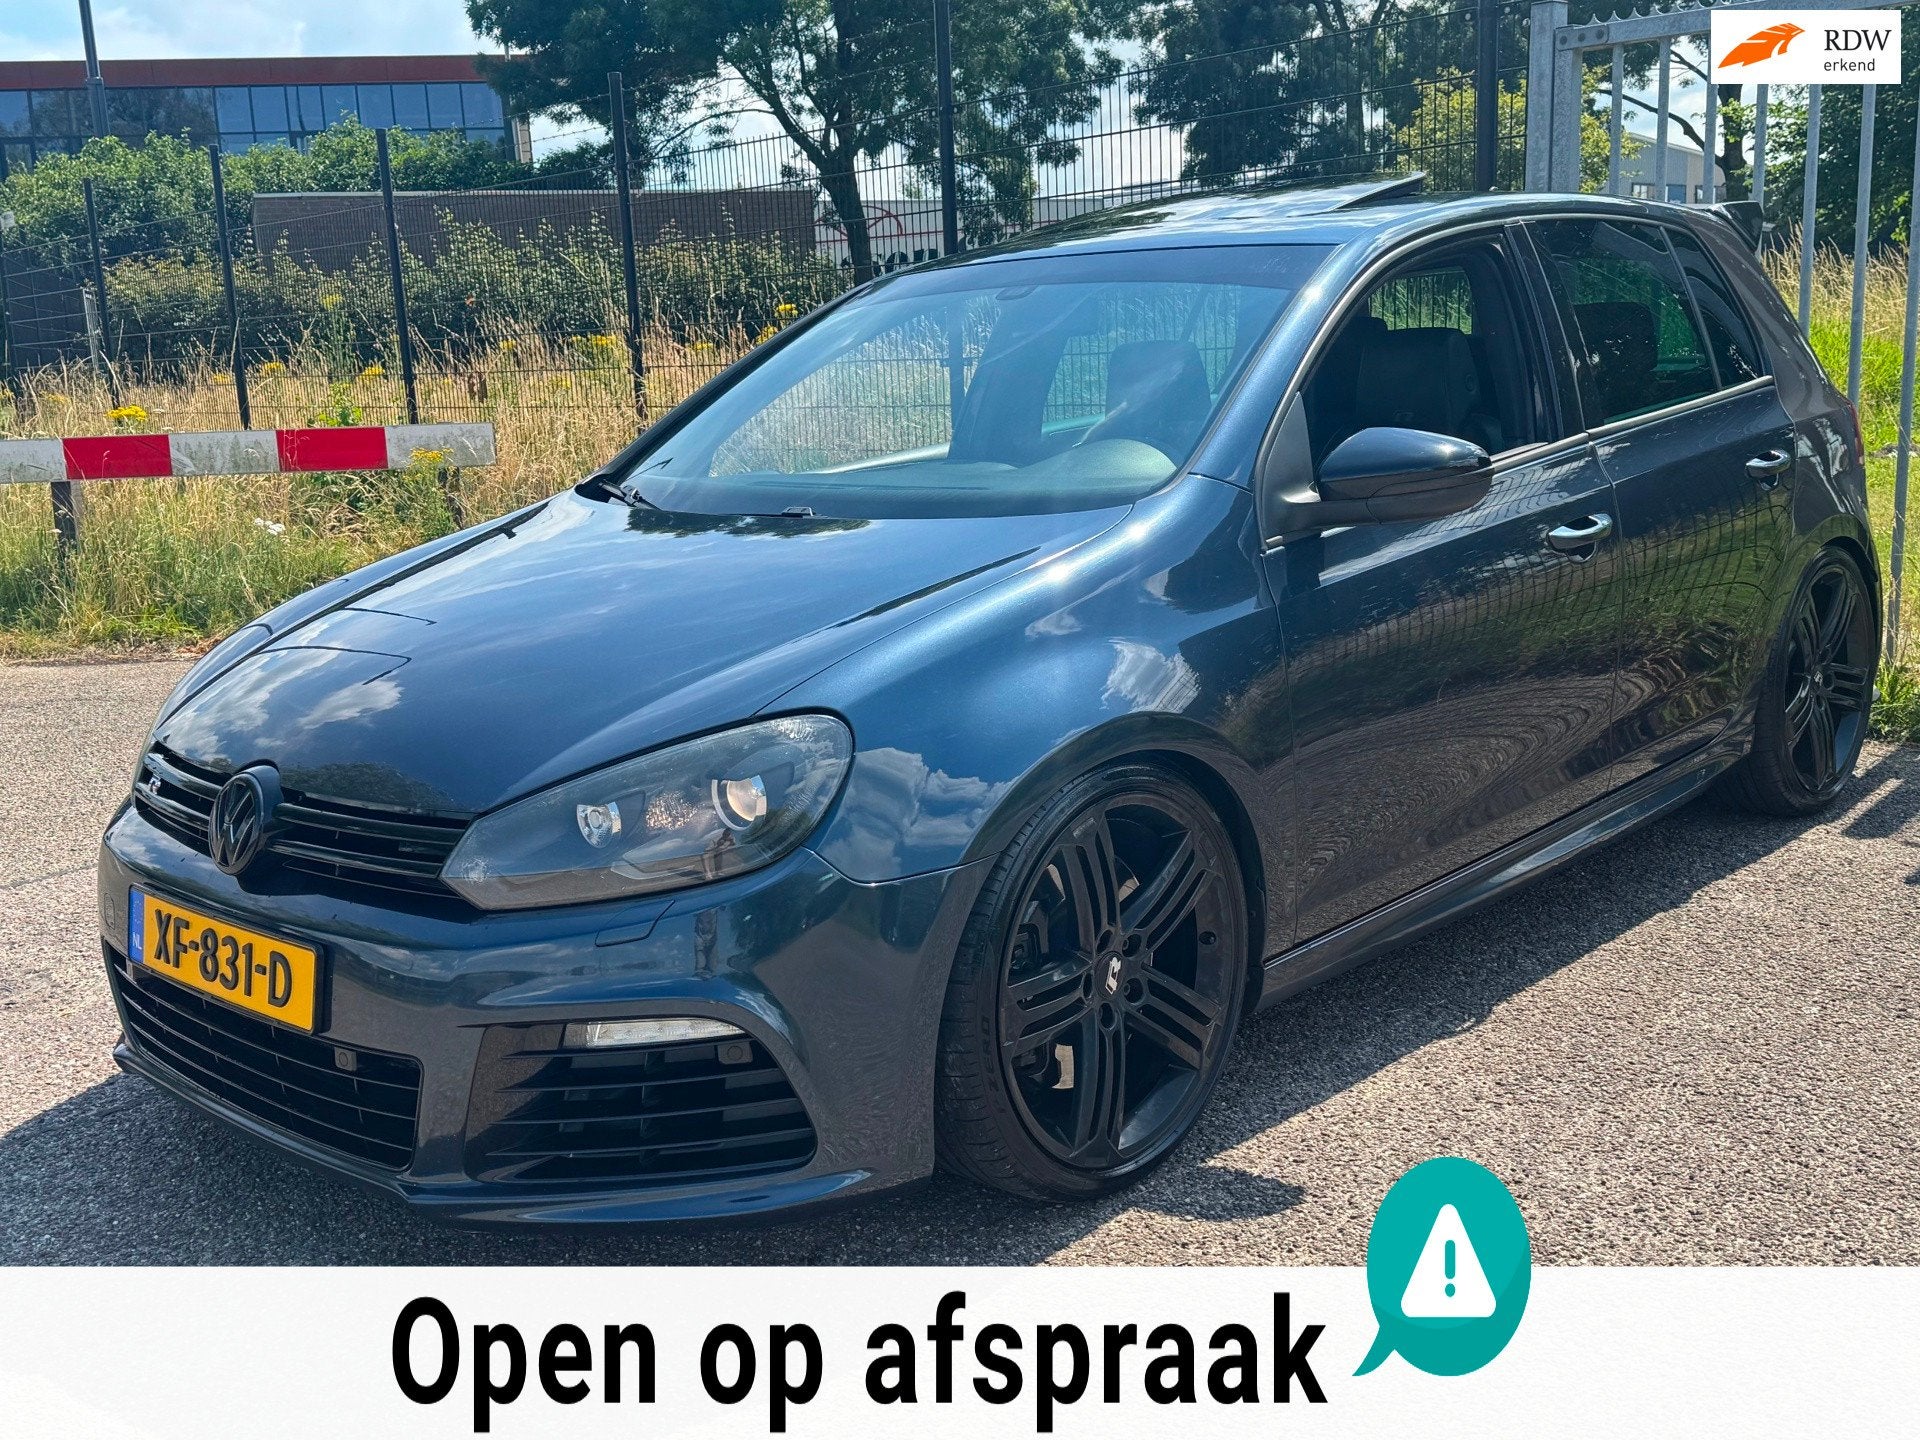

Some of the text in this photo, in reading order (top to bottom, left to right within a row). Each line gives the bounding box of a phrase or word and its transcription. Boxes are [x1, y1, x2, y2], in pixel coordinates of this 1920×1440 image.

[132, 931, 142, 950] NL
[153, 908, 293, 1008] XF-831-D
[1105, 957, 1121, 995] R
